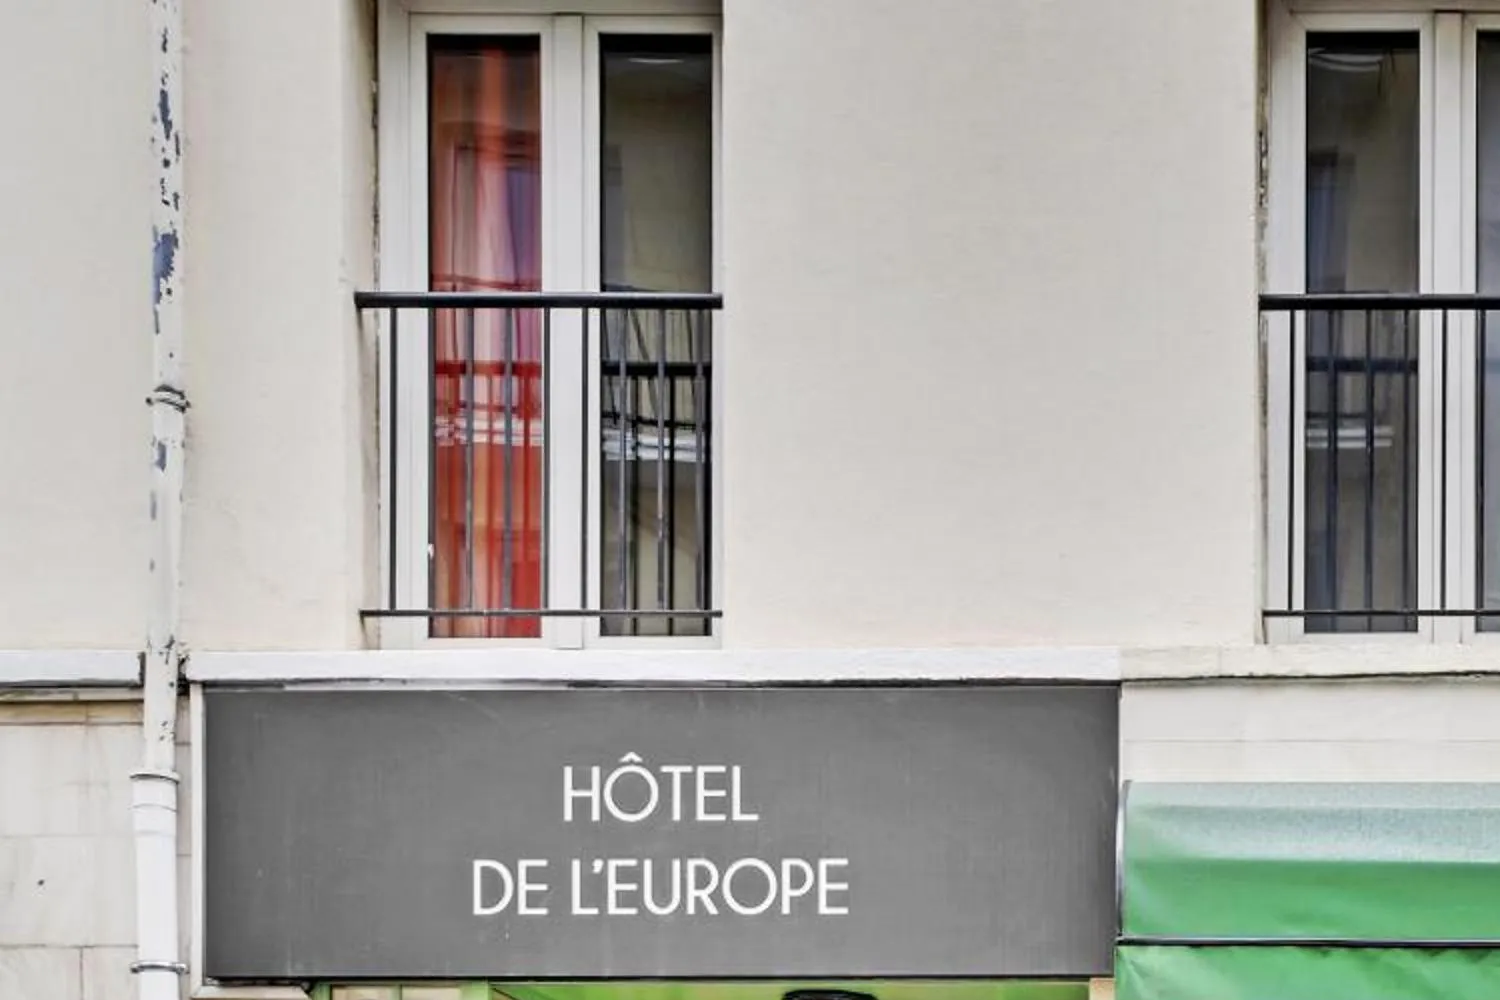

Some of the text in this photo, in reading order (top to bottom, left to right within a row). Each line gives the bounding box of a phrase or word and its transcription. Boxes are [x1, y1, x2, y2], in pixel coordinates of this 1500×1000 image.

[563, 751, 759, 822] HÔTEL
[473, 857, 849, 915] DE L'EUROPE
